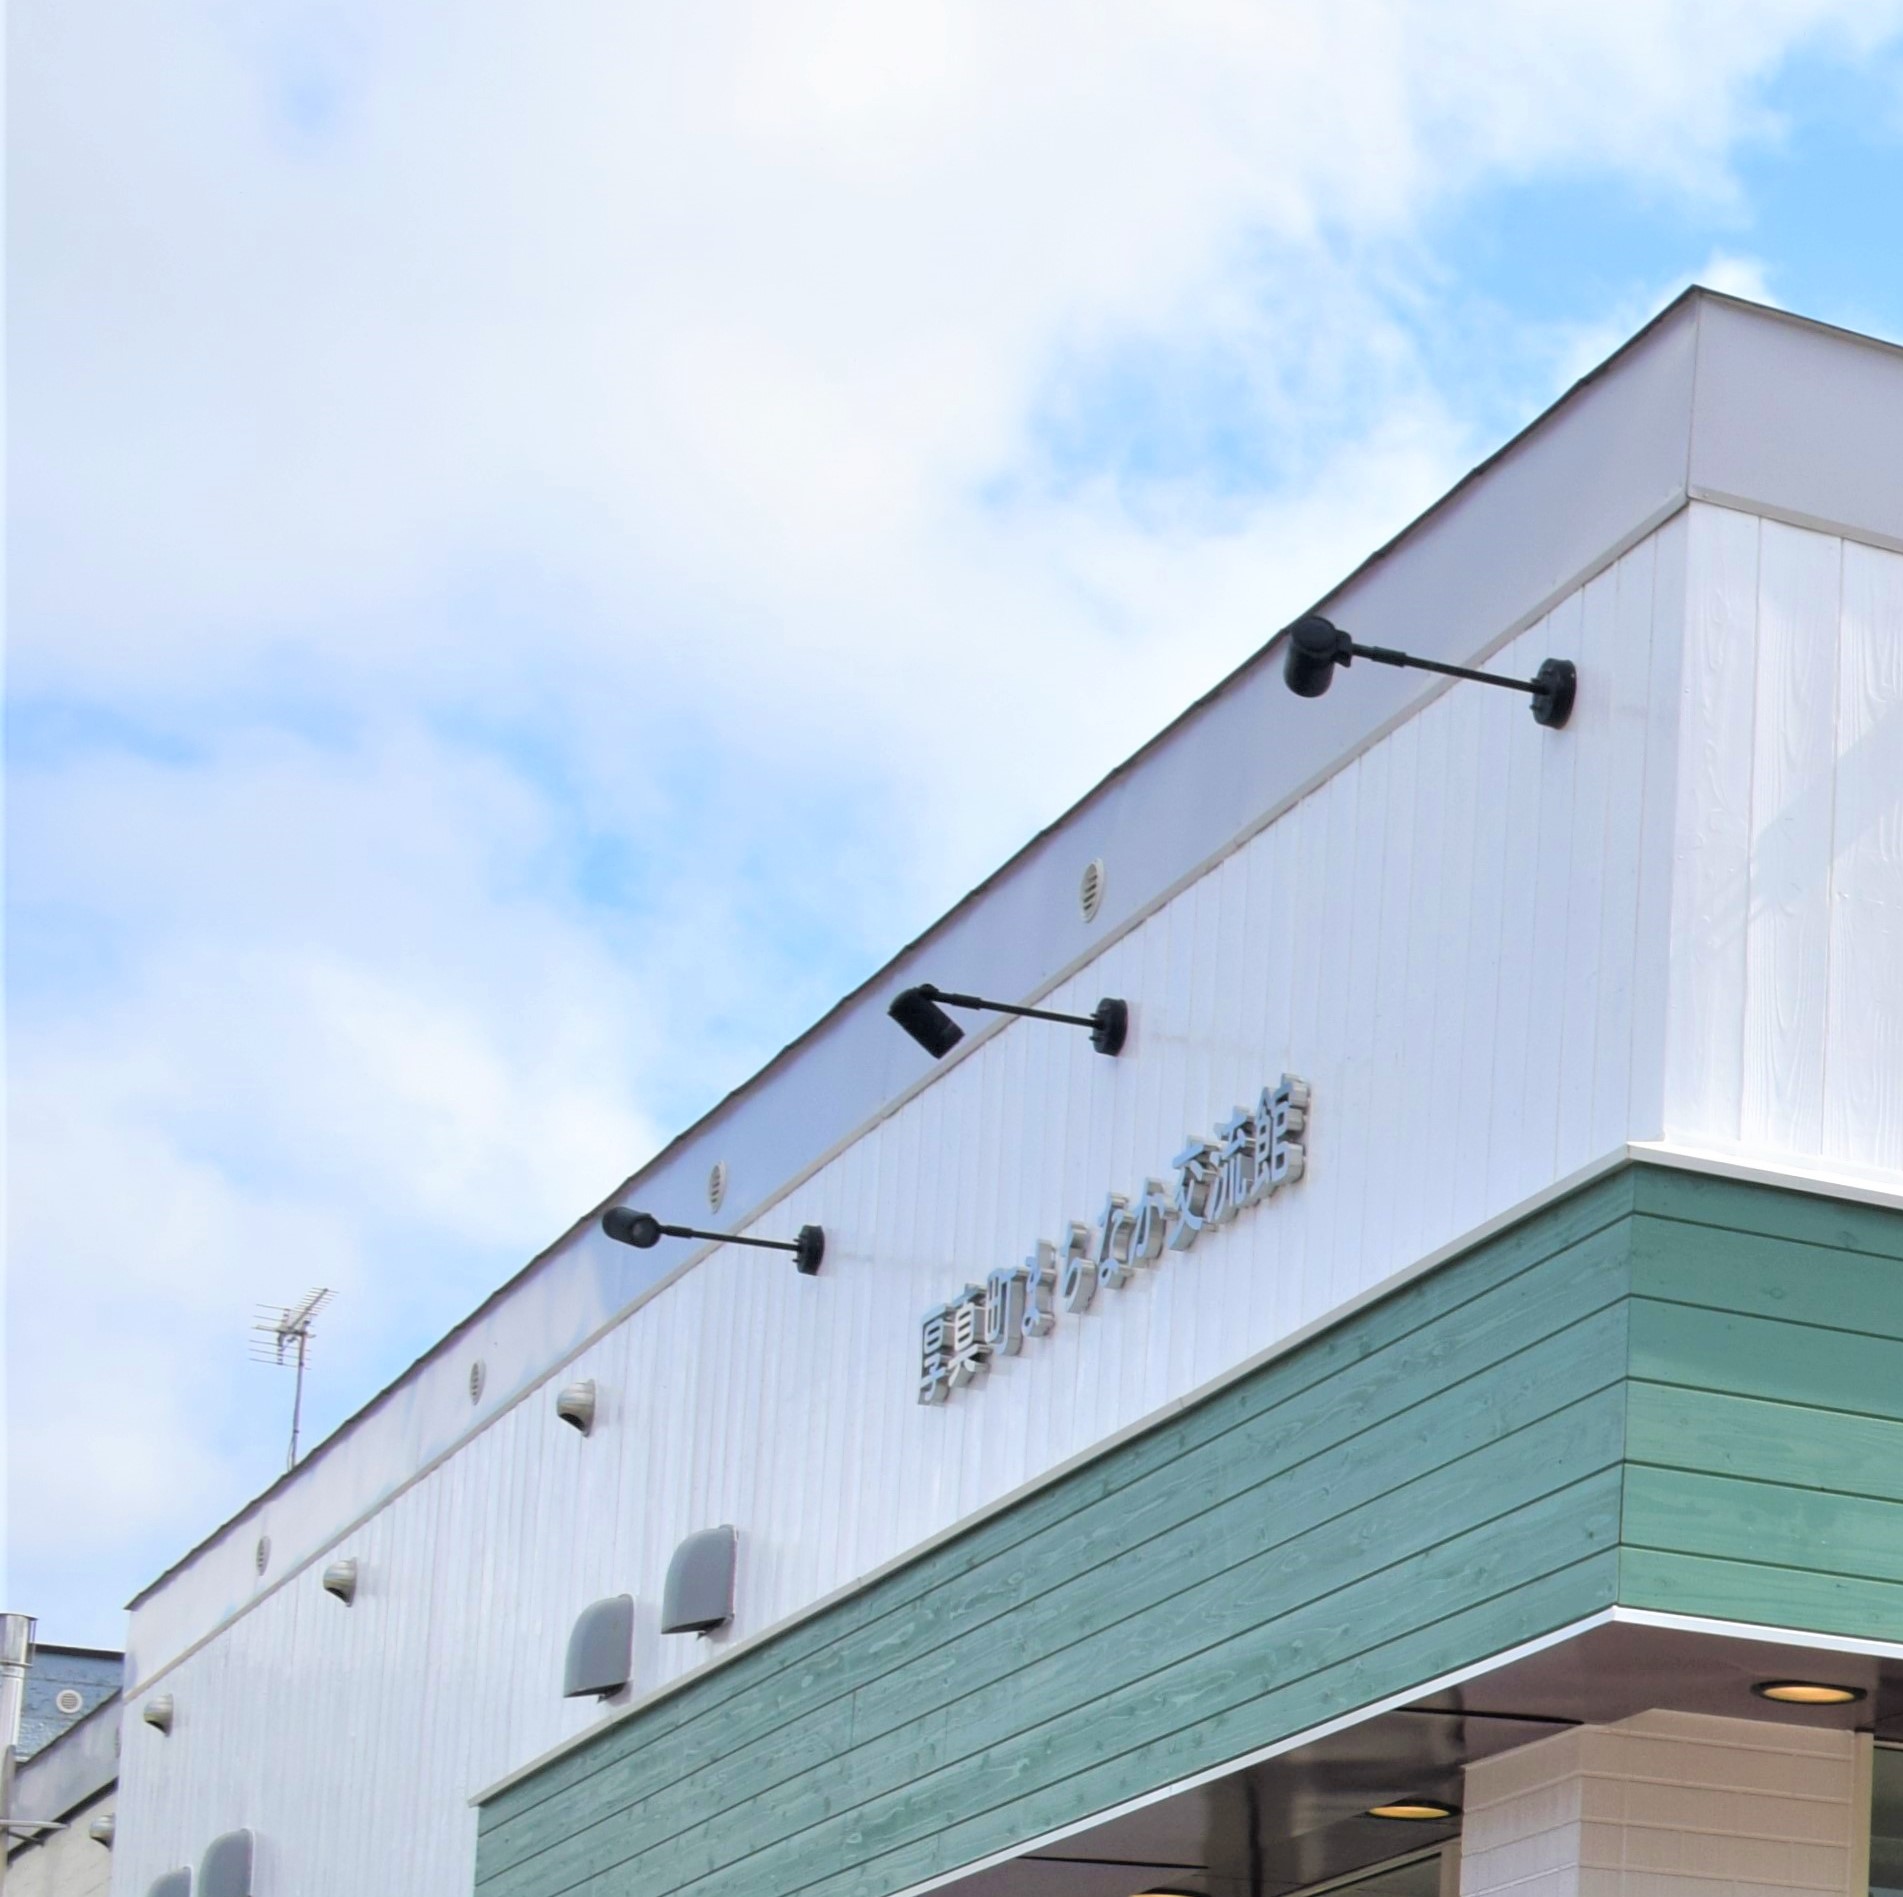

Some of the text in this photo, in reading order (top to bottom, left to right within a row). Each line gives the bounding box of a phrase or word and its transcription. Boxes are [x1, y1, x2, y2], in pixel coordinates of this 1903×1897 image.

[917, 1072, 1311, 1407] 厚真町まちなか交流館
